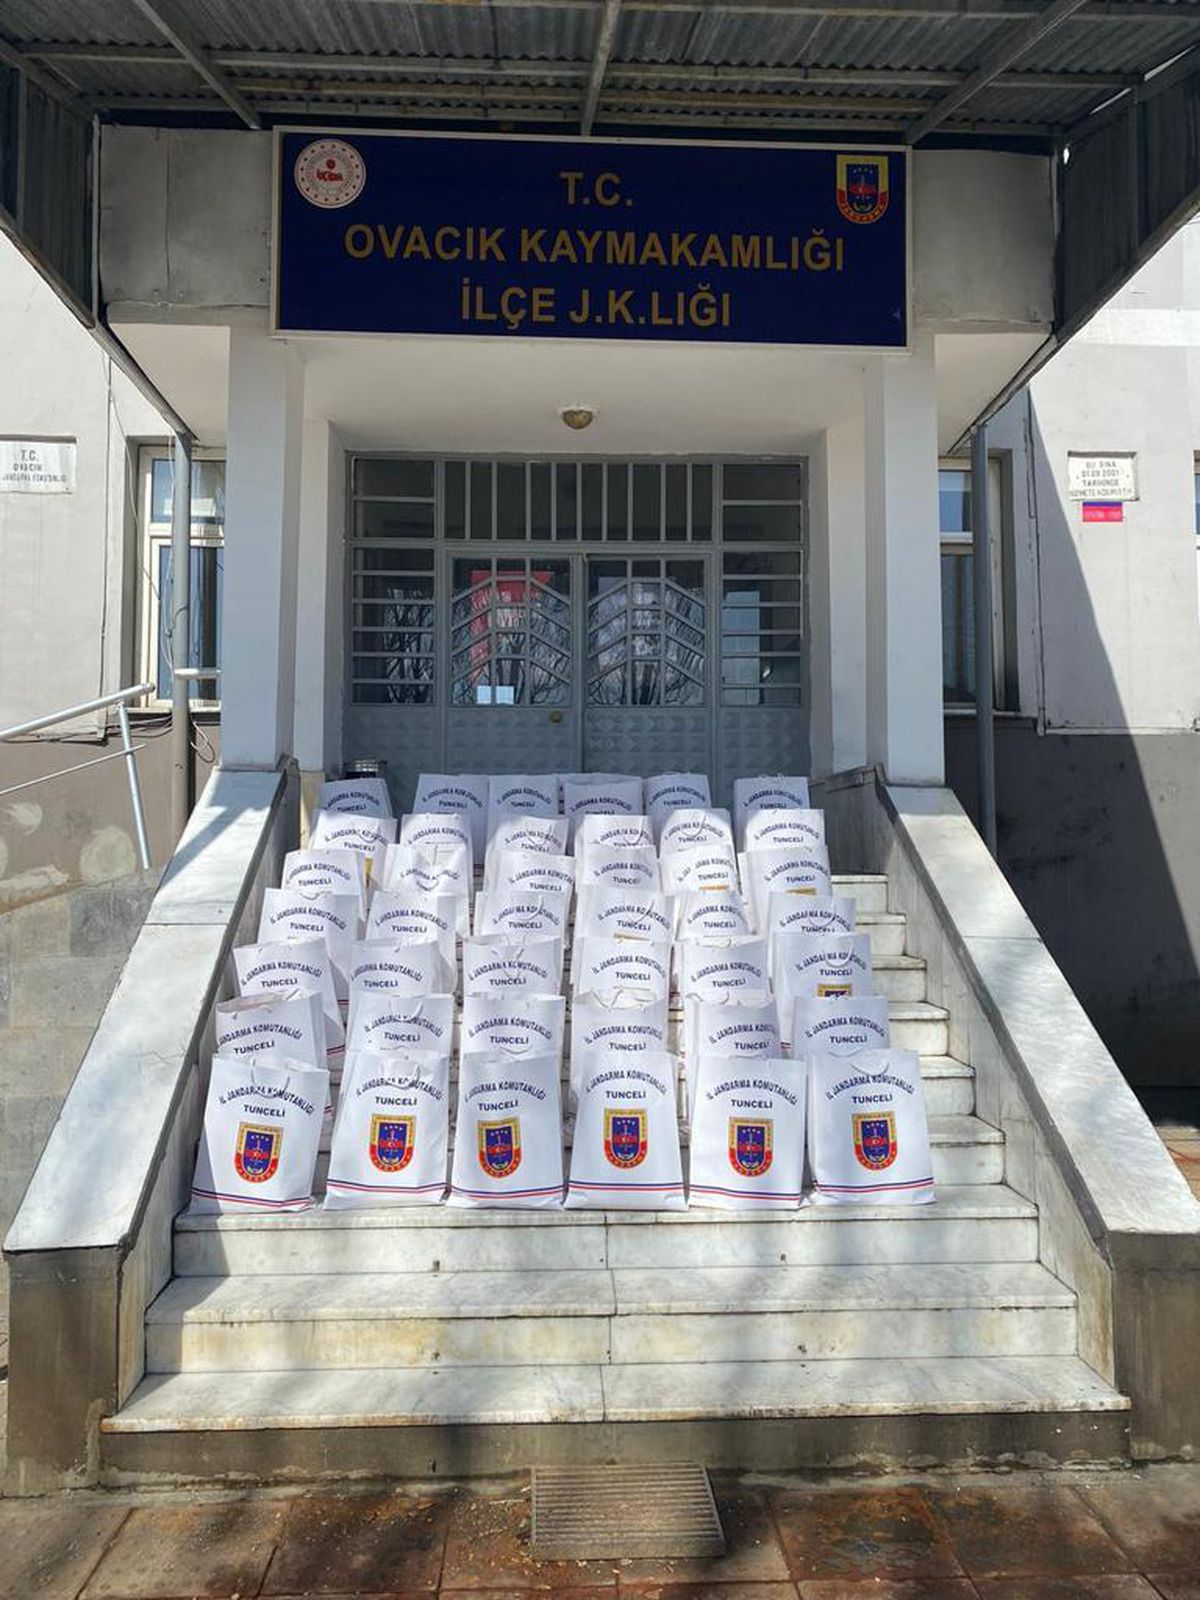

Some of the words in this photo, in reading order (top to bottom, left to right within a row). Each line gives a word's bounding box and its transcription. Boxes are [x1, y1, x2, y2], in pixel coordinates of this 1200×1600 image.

[559, 171, 633, 207] T.C.
[344, 224, 504, 262] OVACIK
[520, 228, 844, 271] KAYMAKAMLIĞI
[461, 277, 555, 329] İLÇE
[570, 284, 731, 327] J.K.LIĞI
[20, 449, 38, 461] T.C.
[615, 971, 651, 980] TUNCELİ
[819, 968, 853, 976] TUNCELİ
[261, 978, 298, 988] TUNCELİ
[363, 979, 398, 988] TUNCELİ
[489, 978, 527, 986] TUNCELİ
[712, 979, 746, 988] TUNCELİ
[383, 1032, 420, 1042] TUNCELİ
[489, 1035, 529, 1045] TUNCELİ
[829, 1035, 868, 1044] TUNCELİ
[233, 1040, 275, 1055] TUNCELİ
[608, 1042, 647, 1051] TUNCELİ
[734, 1041, 770, 1050] TUNCELİ
[605, 1090, 647, 1099] TUNCELİ
[851, 1094, 893, 1104] TUNCELİ
[375, 1096, 418, 1106] TUNCELİ
[478, 1099, 519, 1112] TUNCELİ
[730, 1098, 773, 1109] TUNCELİ
[243, 1104, 286, 1118] TUNCELİ
